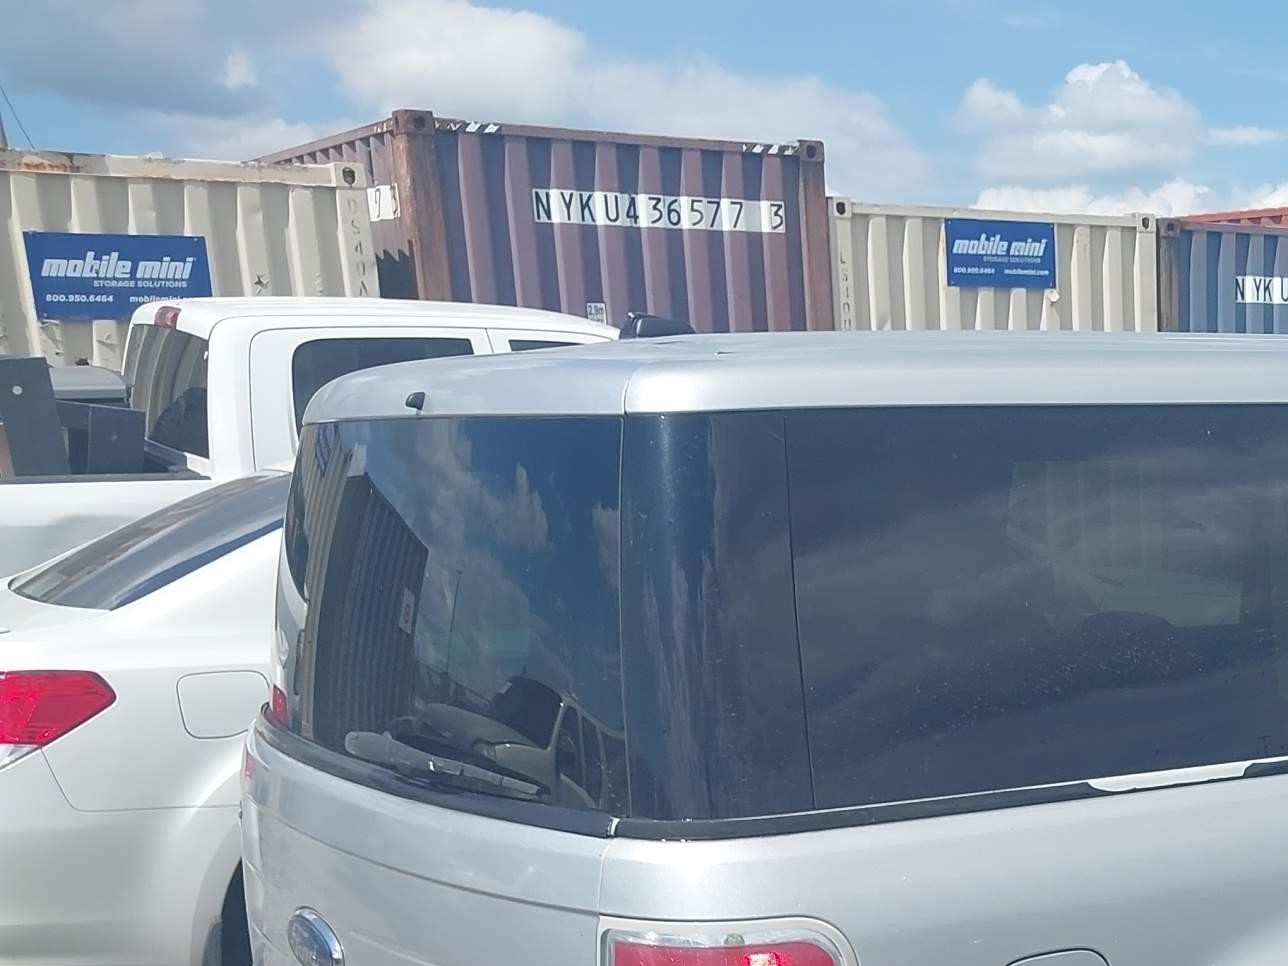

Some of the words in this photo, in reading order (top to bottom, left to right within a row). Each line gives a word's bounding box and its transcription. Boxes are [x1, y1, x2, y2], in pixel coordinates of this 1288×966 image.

[769, 203, 784, 230] 3
[953, 233, 1008, 255] mobile
[1010, 238, 1047, 256] mini
[41, 251, 132, 278] mobile
[136, 257, 194, 279] mini
[94, 280, 135, 288] STORAGE
[46, 294, 114, 302] 800.950.6464
